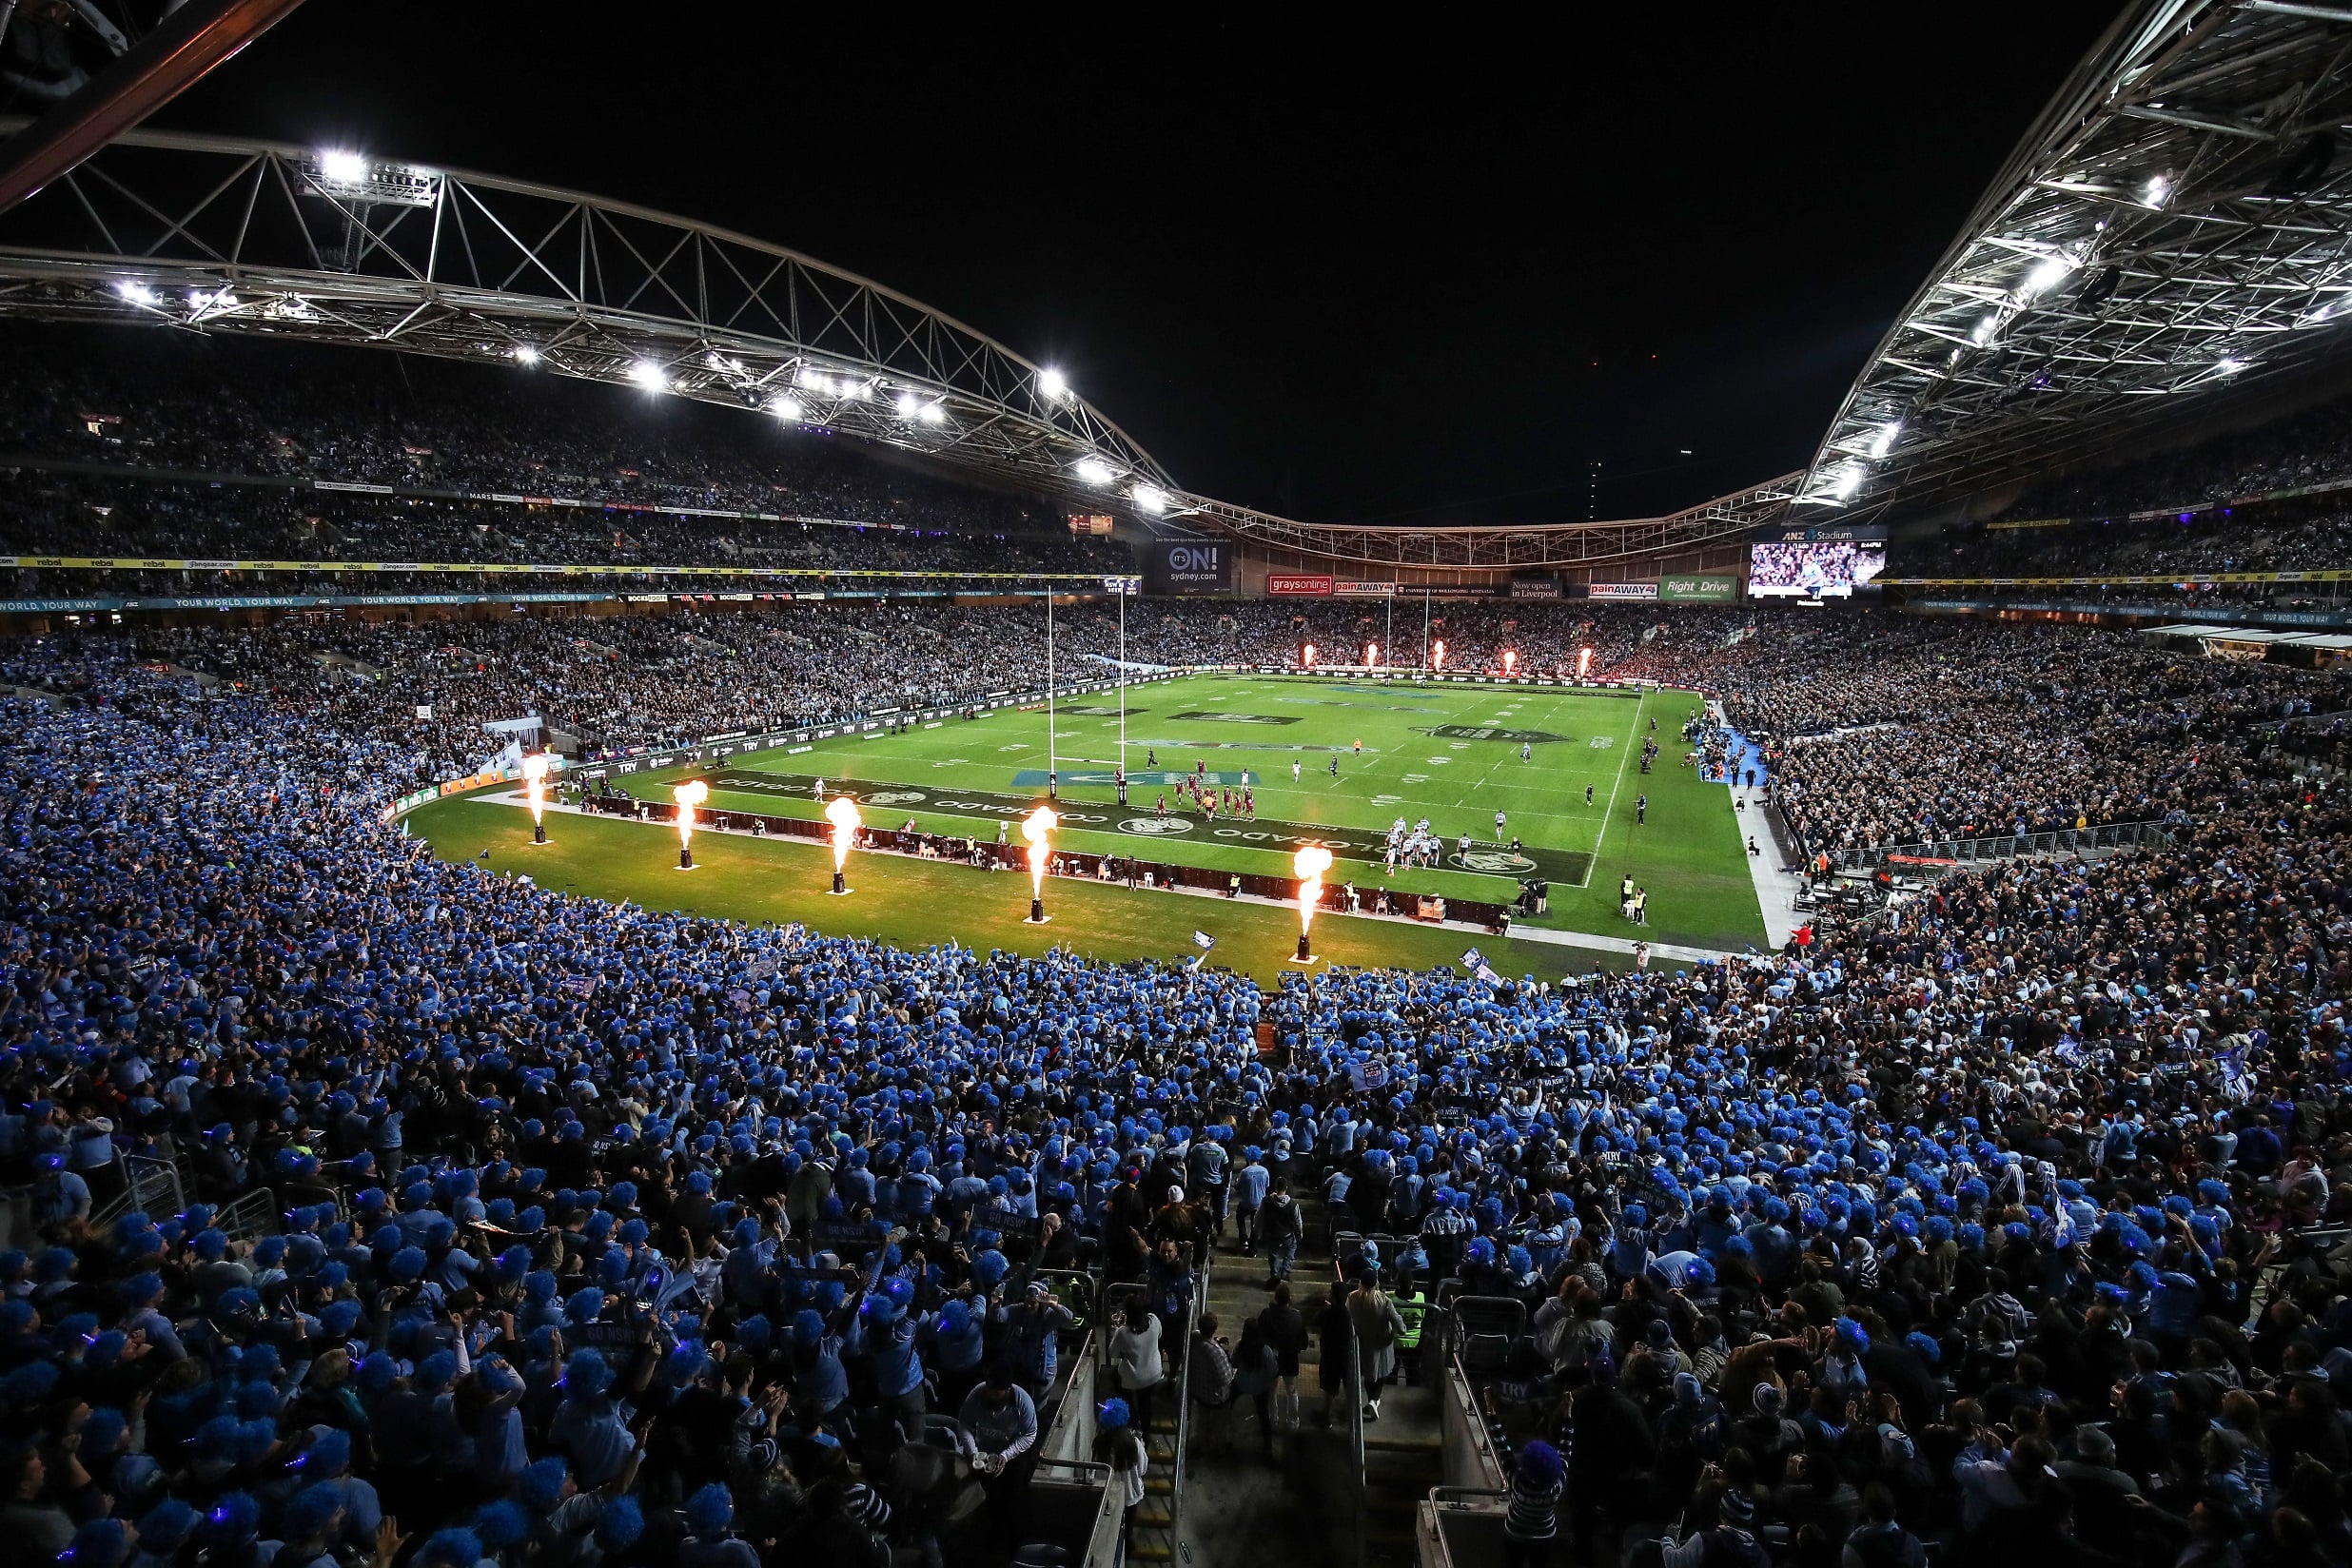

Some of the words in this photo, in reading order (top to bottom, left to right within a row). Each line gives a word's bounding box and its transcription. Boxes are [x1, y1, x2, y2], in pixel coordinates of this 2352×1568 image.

[1783, 532, 1805, 540] ANZ
[1817, 531, 1852, 540] Stadium
[1169, 547, 1217, 570] ON!
[1171, 572, 1217, 582] sydney.com
[1274, 579, 1328, 590] graysonline
[1336, 583, 1385, 591] painAWAY
[1591, 585, 1646, 594] painAWAY
[1521, 590, 1558, 599] Liverpool
[42, 601, 70, 609] YOUR
[73, 601, 97, 609] WAY
[176, 598, 202, 607] YOUR
[206, 598, 242, 608] WORLD,
[245, 597, 271, 606] YOUR
[274, 598, 294, 606] WAY
[843, 724, 856, 735] TRY
[795, 732, 810, 743] TRY
[743, 741, 759, 752] TRY
[618, 762, 637, 774] TRY
[409, 793, 421, 807] nib
[423, 788, 438, 802] nib
[1287, 821, 1338, 831] Holden
[989, 1212, 1002, 1222] GO
[1003, 1214, 1027, 1227] NSW!
[827, 1225, 839, 1235] GO
[587, 1327, 599, 1341] GO
[1499, 1381, 1528, 1398] TRY
